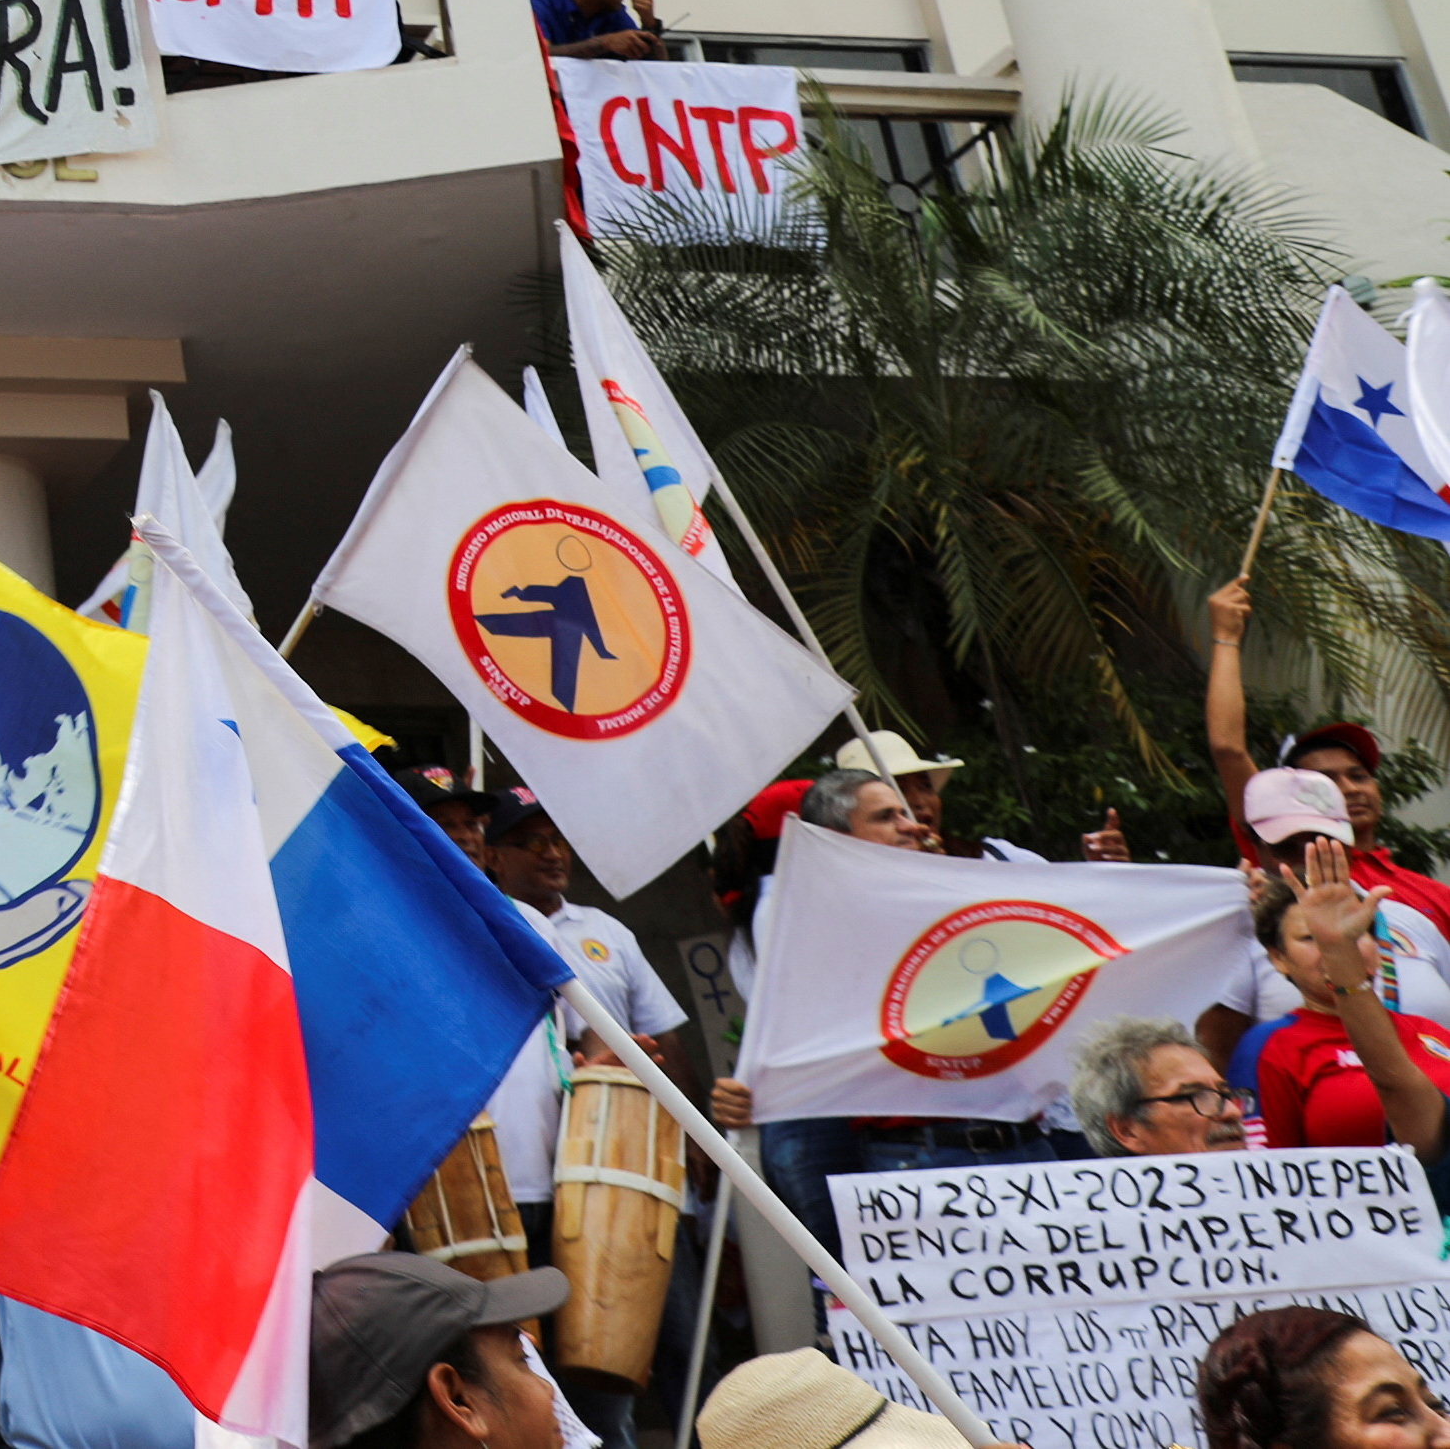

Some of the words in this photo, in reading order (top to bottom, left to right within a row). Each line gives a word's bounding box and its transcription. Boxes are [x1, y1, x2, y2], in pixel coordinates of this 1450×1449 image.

[600, 95, 798, 195] CNTP
[455, 532, 489, 593] SINDICATO
[483, 509, 545, 536] NACIONAL
[544, 507, 565, 520] DE
[563, 512, 657, 577] TRABAJADORES
[651, 576, 671, 596] DE
[479, 655, 531, 707] SINTUP
[854, 1183, 922, 1223] HOY
[1233, 1155, 1411, 1200] INDEPEN
[1035, 1219, 1127, 1255] DEL
[1365, 1204, 1423, 1237] DE
[869, 1273, 925, 1307] LA
[842, 1322, 958, 1371] HATA
[1054, 1309, 1113, 1354] LOS
